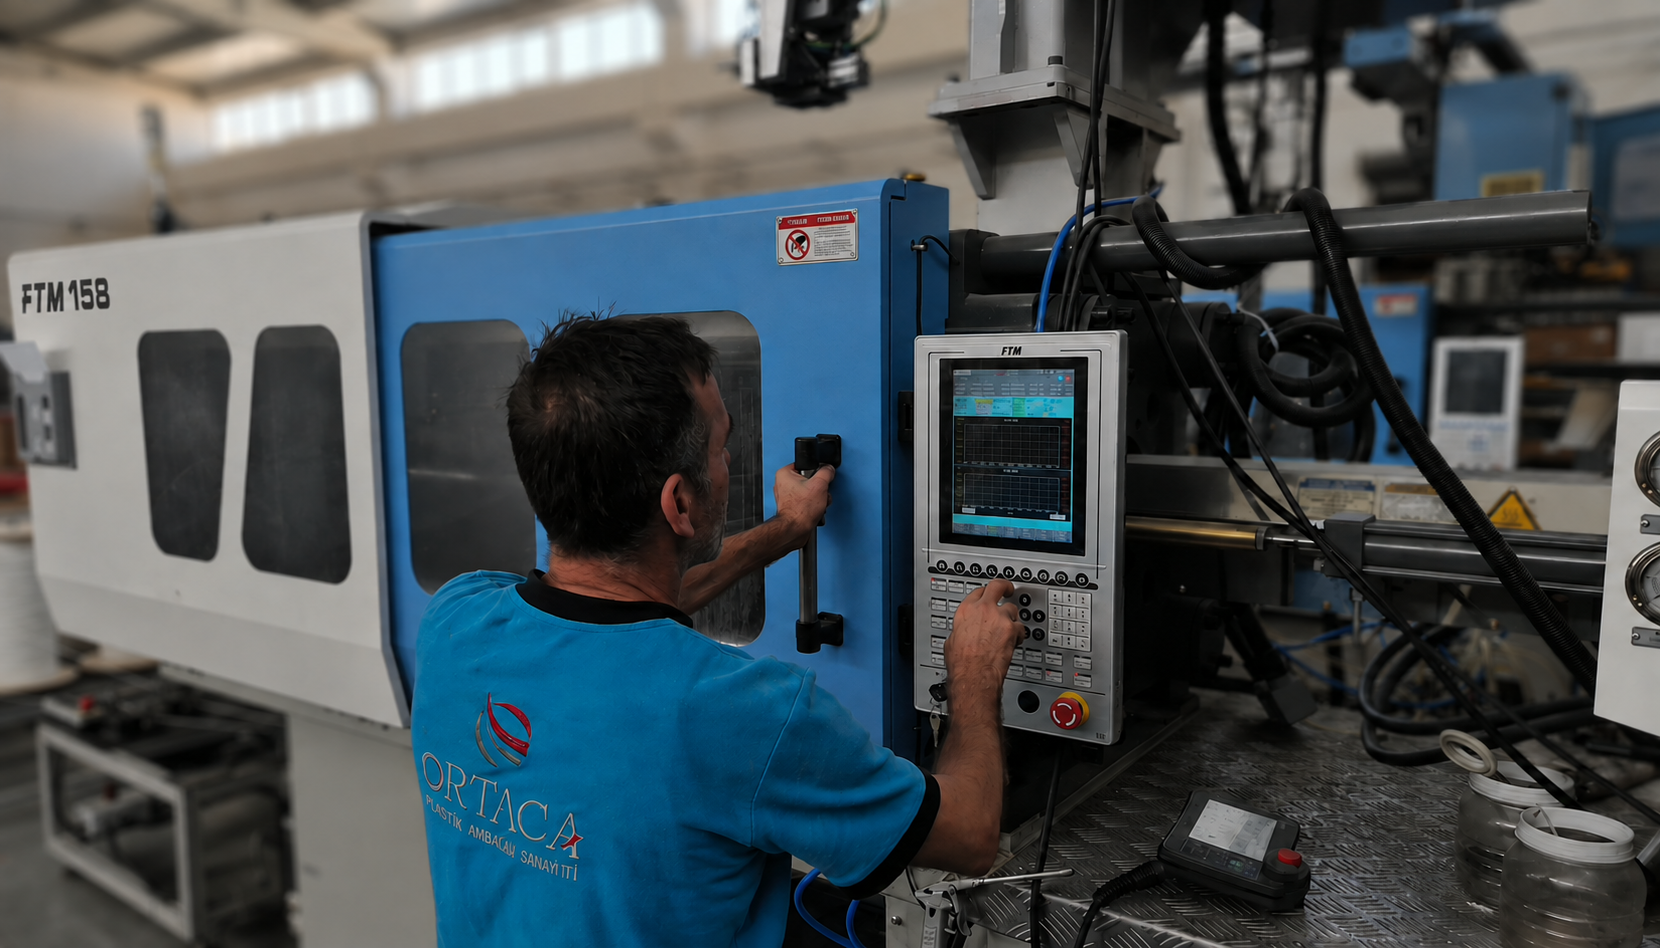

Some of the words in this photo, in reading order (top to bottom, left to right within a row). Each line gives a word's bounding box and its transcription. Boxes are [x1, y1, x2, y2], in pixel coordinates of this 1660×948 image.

[22, 281, 64, 314] FTM
[68, 277, 110, 312] 158
[1001, 345, 1022, 356] FTM
[421, 751, 583, 860] ORTACA
[425, 794, 463, 832] PLASTİK
